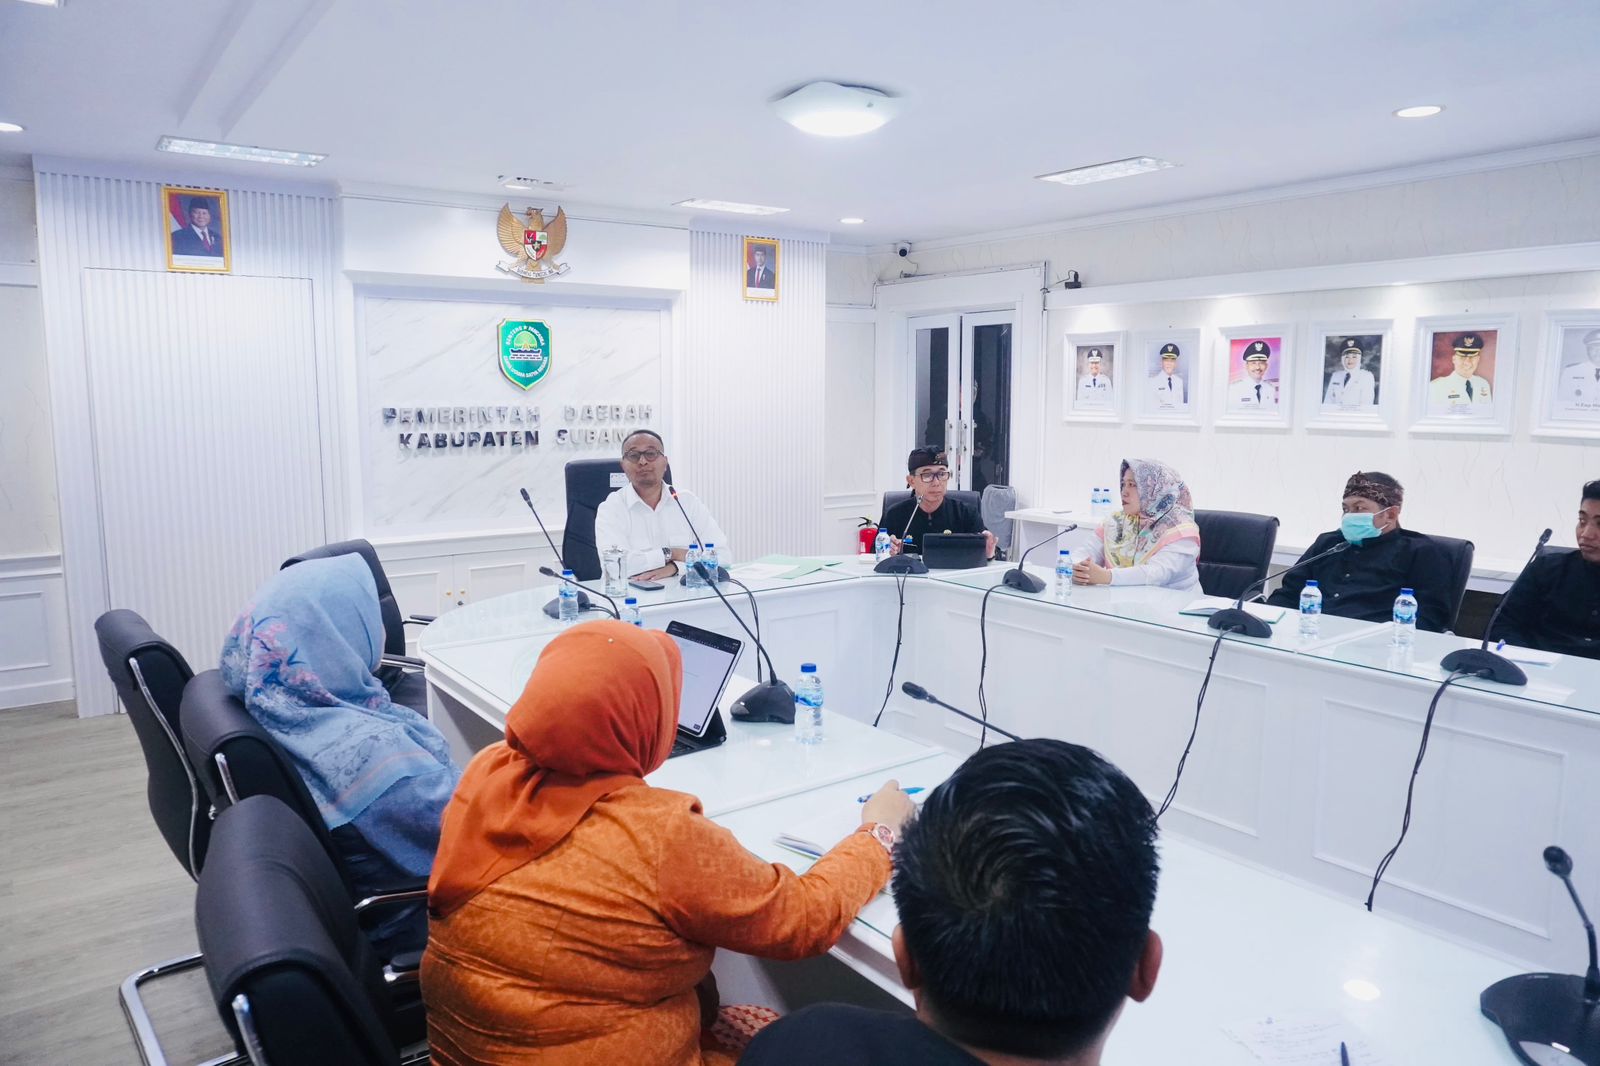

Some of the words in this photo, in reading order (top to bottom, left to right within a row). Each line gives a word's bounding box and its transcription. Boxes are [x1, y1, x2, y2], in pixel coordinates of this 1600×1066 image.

[382, 405, 540, 425] PEMERINTAH
[564, 403, 652, 421] DAERAH
[399, 430, 539, 449] KABUPATEN
